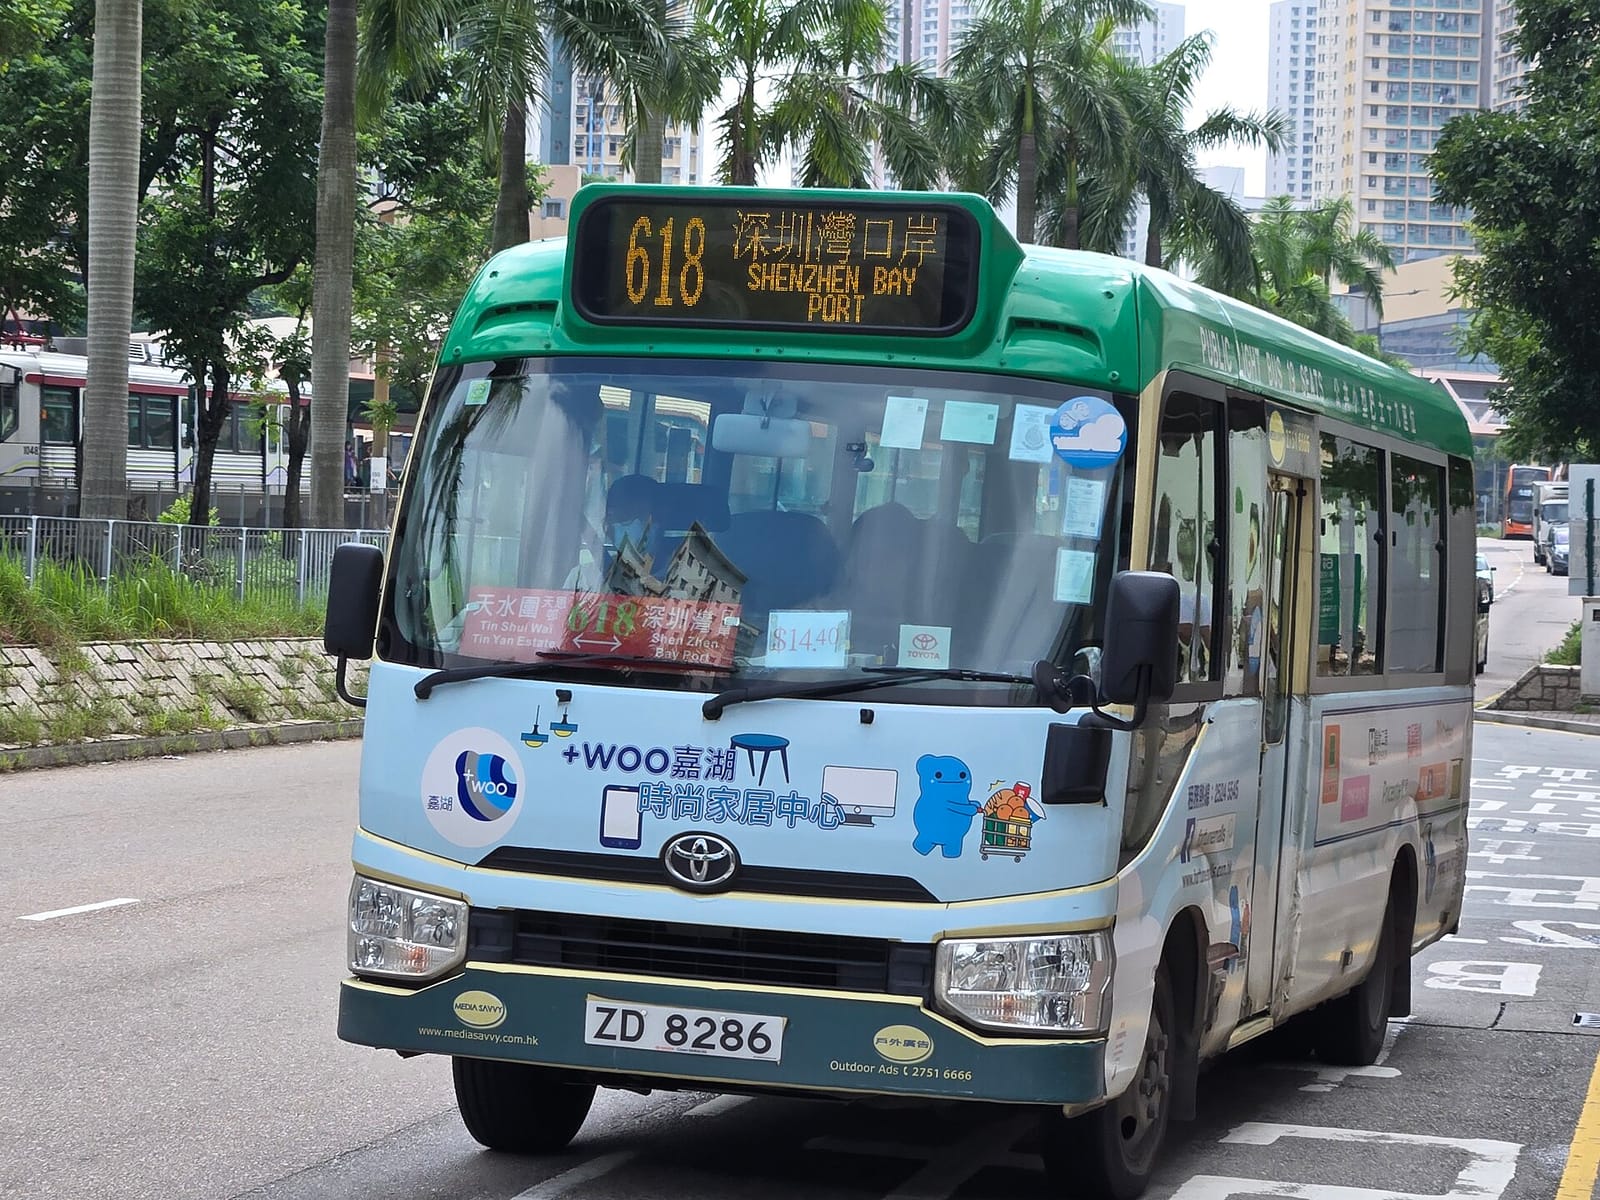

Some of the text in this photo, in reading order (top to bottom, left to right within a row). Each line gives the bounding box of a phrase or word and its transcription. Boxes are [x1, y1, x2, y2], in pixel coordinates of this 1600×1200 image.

[732, 209, 939, 267] 深圳灣口岸
[625, 215, 707, 307] 618
[747, 262, 917, 296] SHENZHEN BAY
[807, 293, 865, 323] PORT
[1199, 326, 1233, 373] PUBLIC
[1265, 351, 1283, 389] BUS
[473, 593, 540, 619] 天水圍
[568, 600, 638, 636] 618
[642, 605, 713, 634] 深圳灣
[472, 634, 490, 645] Tin
[492, 634, 514, 646] Yan
[480, 620, 497, 632] Tin
[501, 621, 528, 633] Shui
[651, 633, 684, 646] Shen
[773, 624, 839, 654] $14.40
[655, 647, 680, 661] Bay
[907, 650, 940, 660] TOYOTA
[637, 782, 847, 829] 時尚家居中心
[454, 1002, 503, 1013] MEDIA SAVVY
[418, 1027, 539, 1045] www.mediasavvy.com.hk
[593, 1006, 773, 1055] ZD 8286
[830, 1060, 973, 1081] Outdoor Ads 2751 6666
